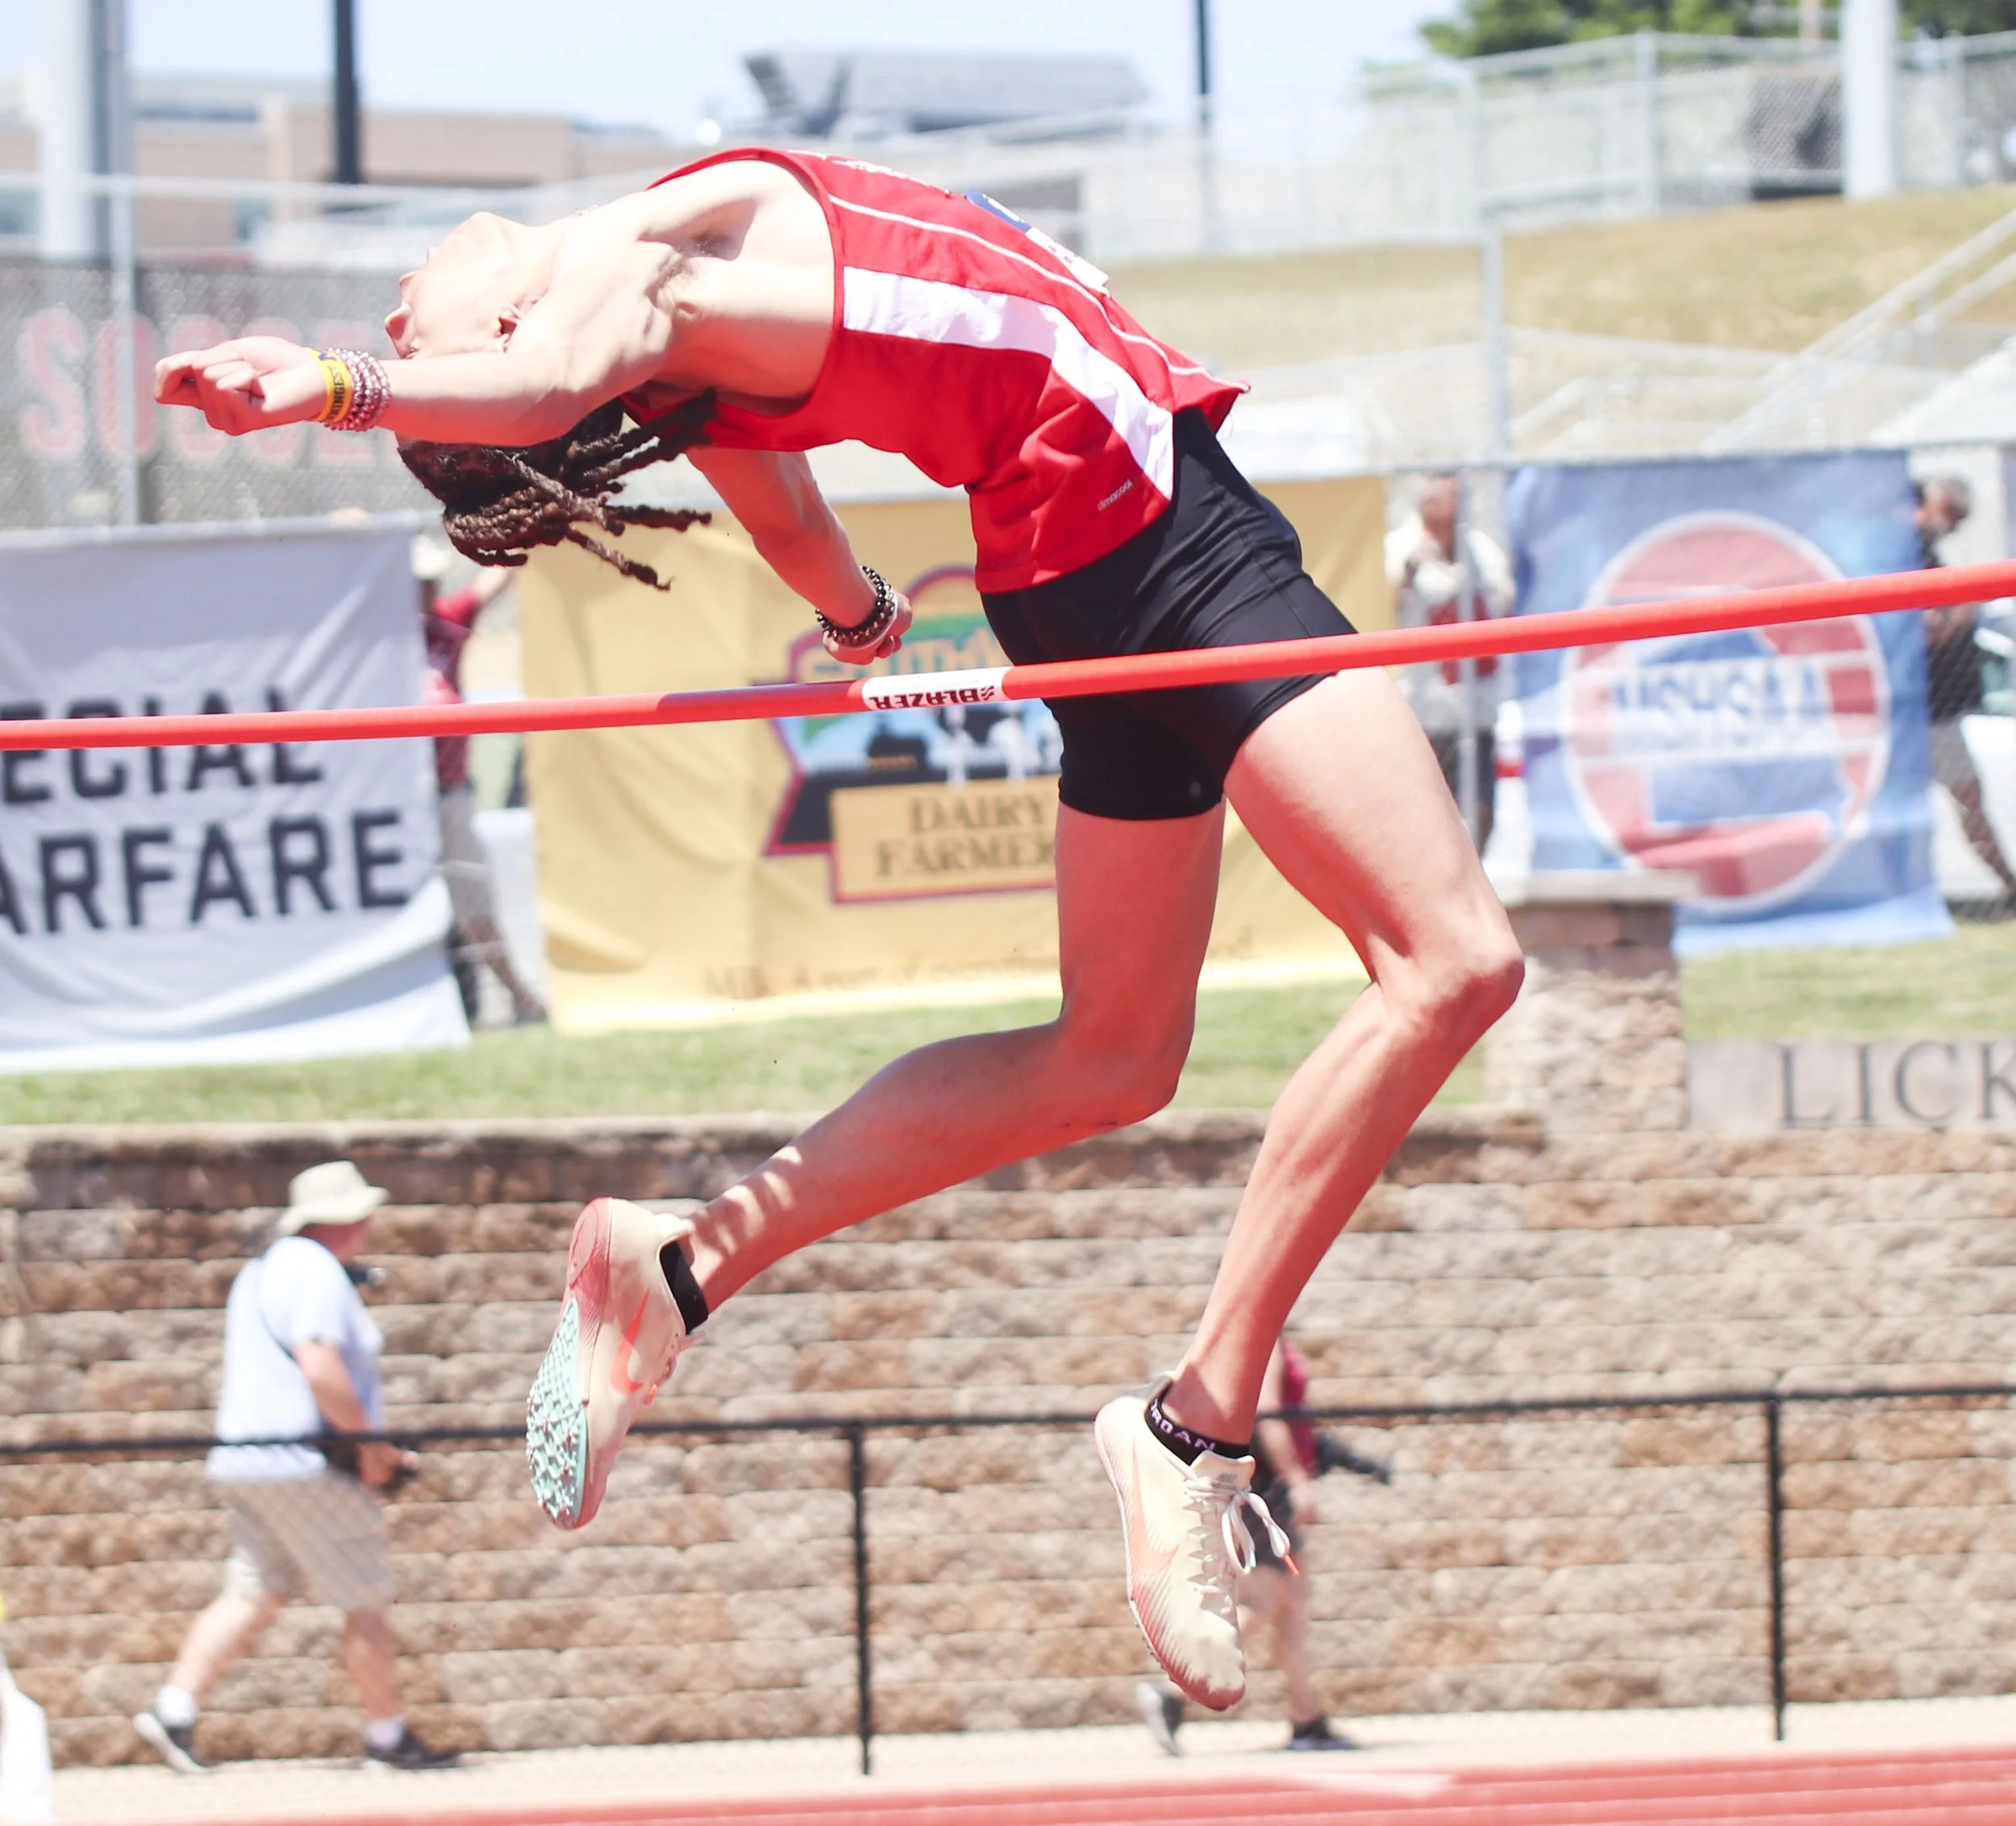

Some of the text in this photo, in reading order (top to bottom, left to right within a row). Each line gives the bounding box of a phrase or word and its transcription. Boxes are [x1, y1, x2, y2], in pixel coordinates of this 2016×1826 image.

[17, 308, 401, 465] SOCCE
[868, 688, 979, 710] BLAZER
[0, 689, 323, 803] ECIAL
[909, 792, 1052, 834] DAIRY
[1776, 1039, 2016, 1127] LICK
